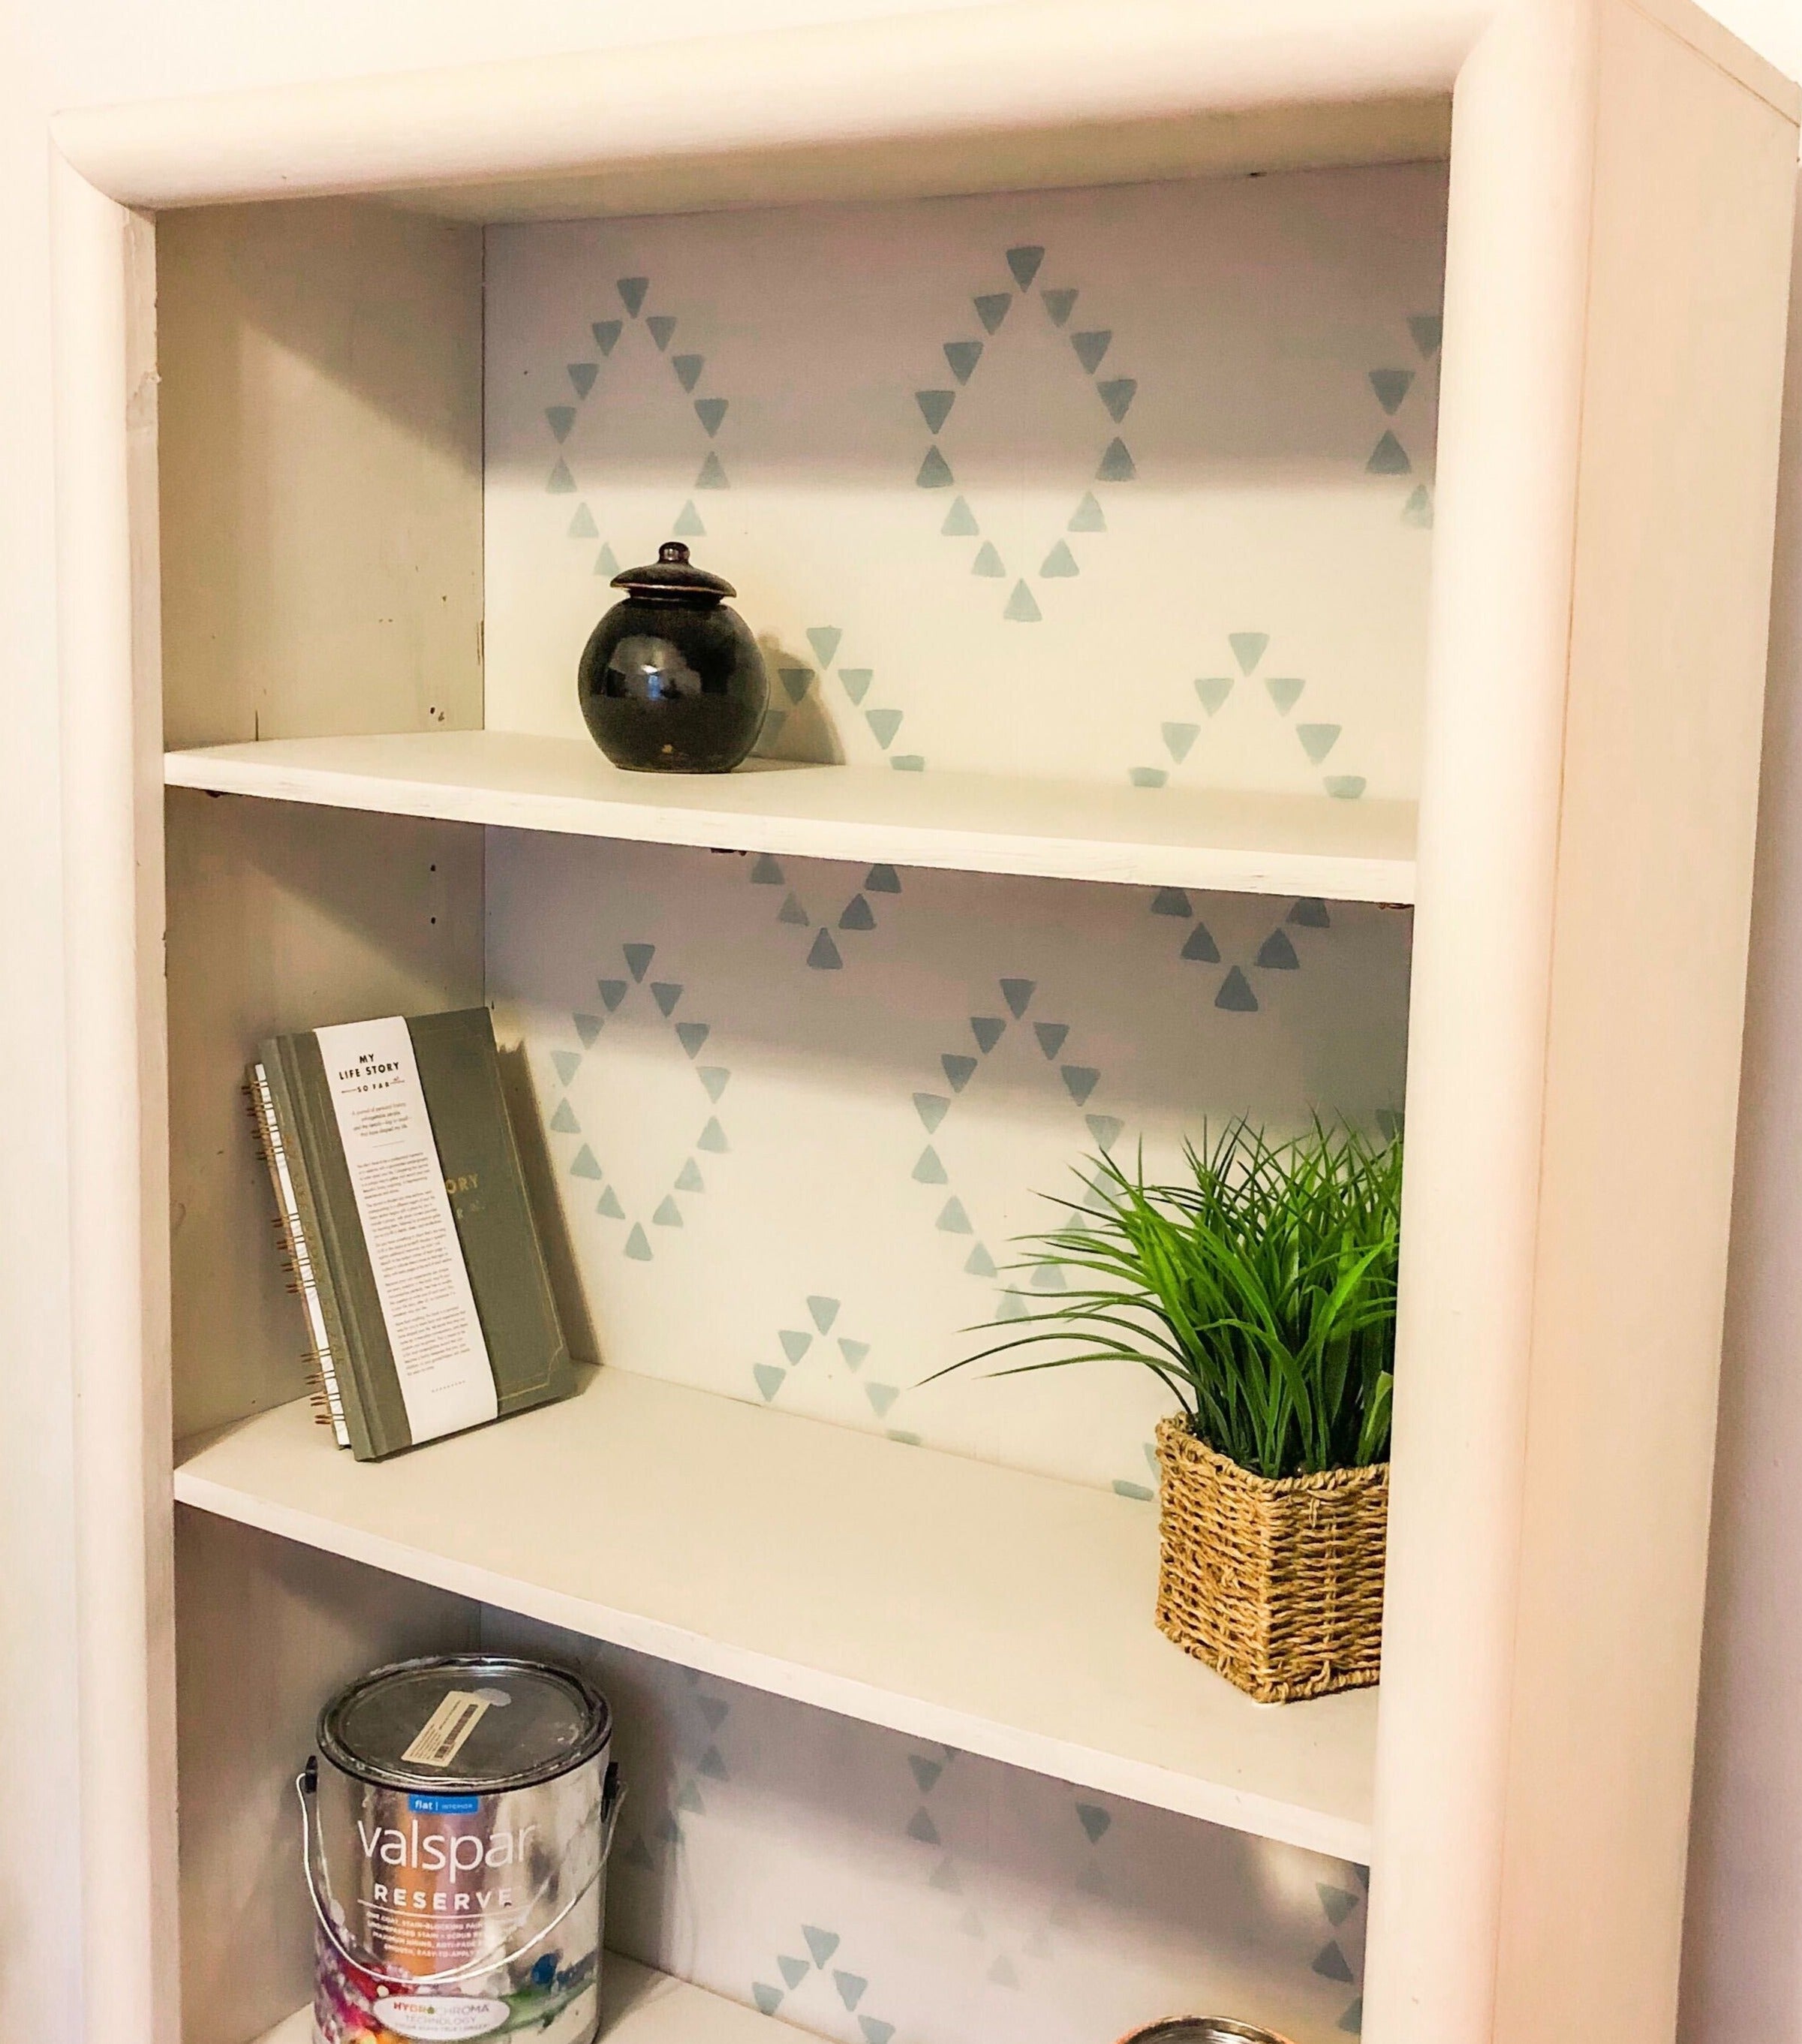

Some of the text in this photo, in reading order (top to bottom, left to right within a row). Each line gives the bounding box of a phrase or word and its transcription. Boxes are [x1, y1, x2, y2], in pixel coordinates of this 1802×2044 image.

[359, 1053, 374, 1064] MY
[338, 1061, 399, 1080] LIFE STORY
[372, 1082, 390, 1090] FAR
[445, 1173, 478, 1194] ORY
[415, 1799, 433, 1810] flat
[357, 1820, 536, 1883] valspar
[375, 1883, 513, 1911] RESERVE
